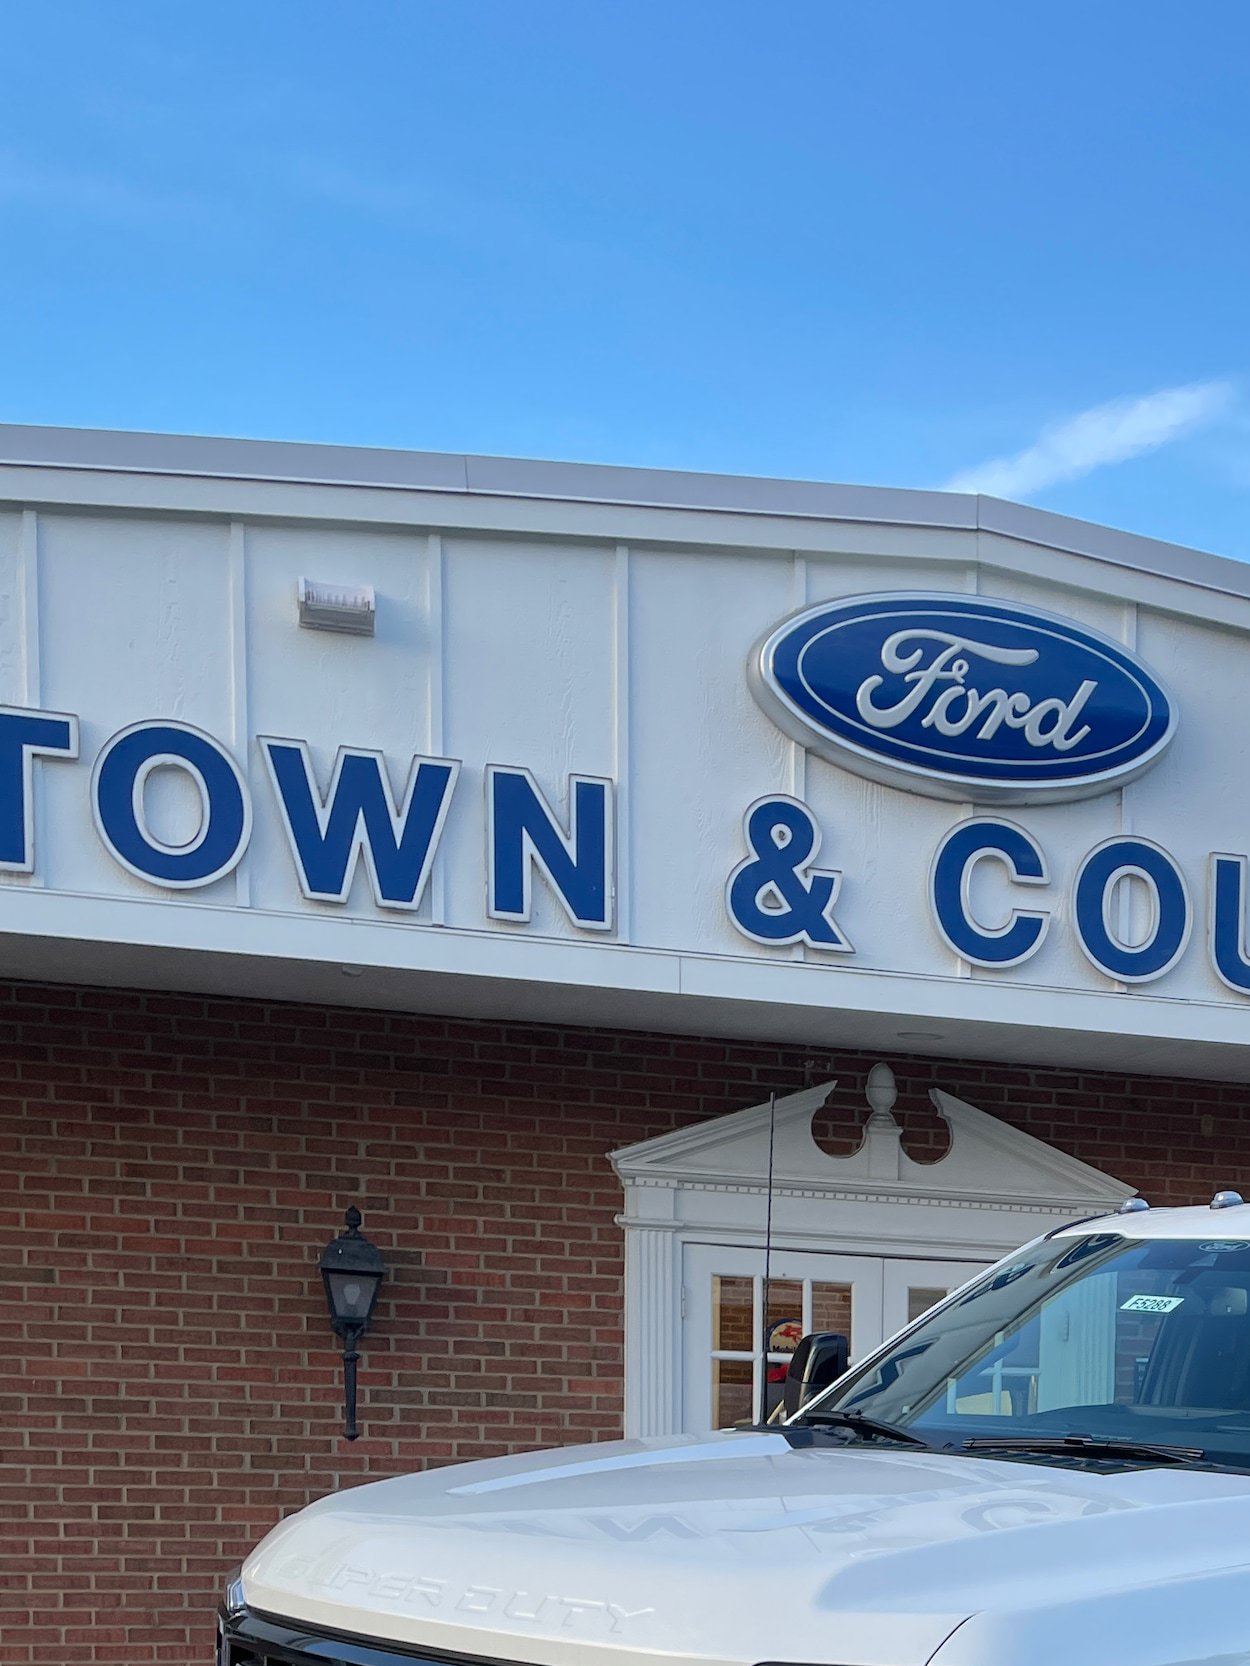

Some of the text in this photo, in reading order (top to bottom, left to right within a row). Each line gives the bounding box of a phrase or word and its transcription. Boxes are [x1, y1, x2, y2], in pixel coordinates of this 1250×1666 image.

[856, 629, 1098, 751] Ford
[0, 704, 614, 932] TOWN
[725, 794, 856, 954] &
[275, 1553, 655, 1635] SUPER DUTY
